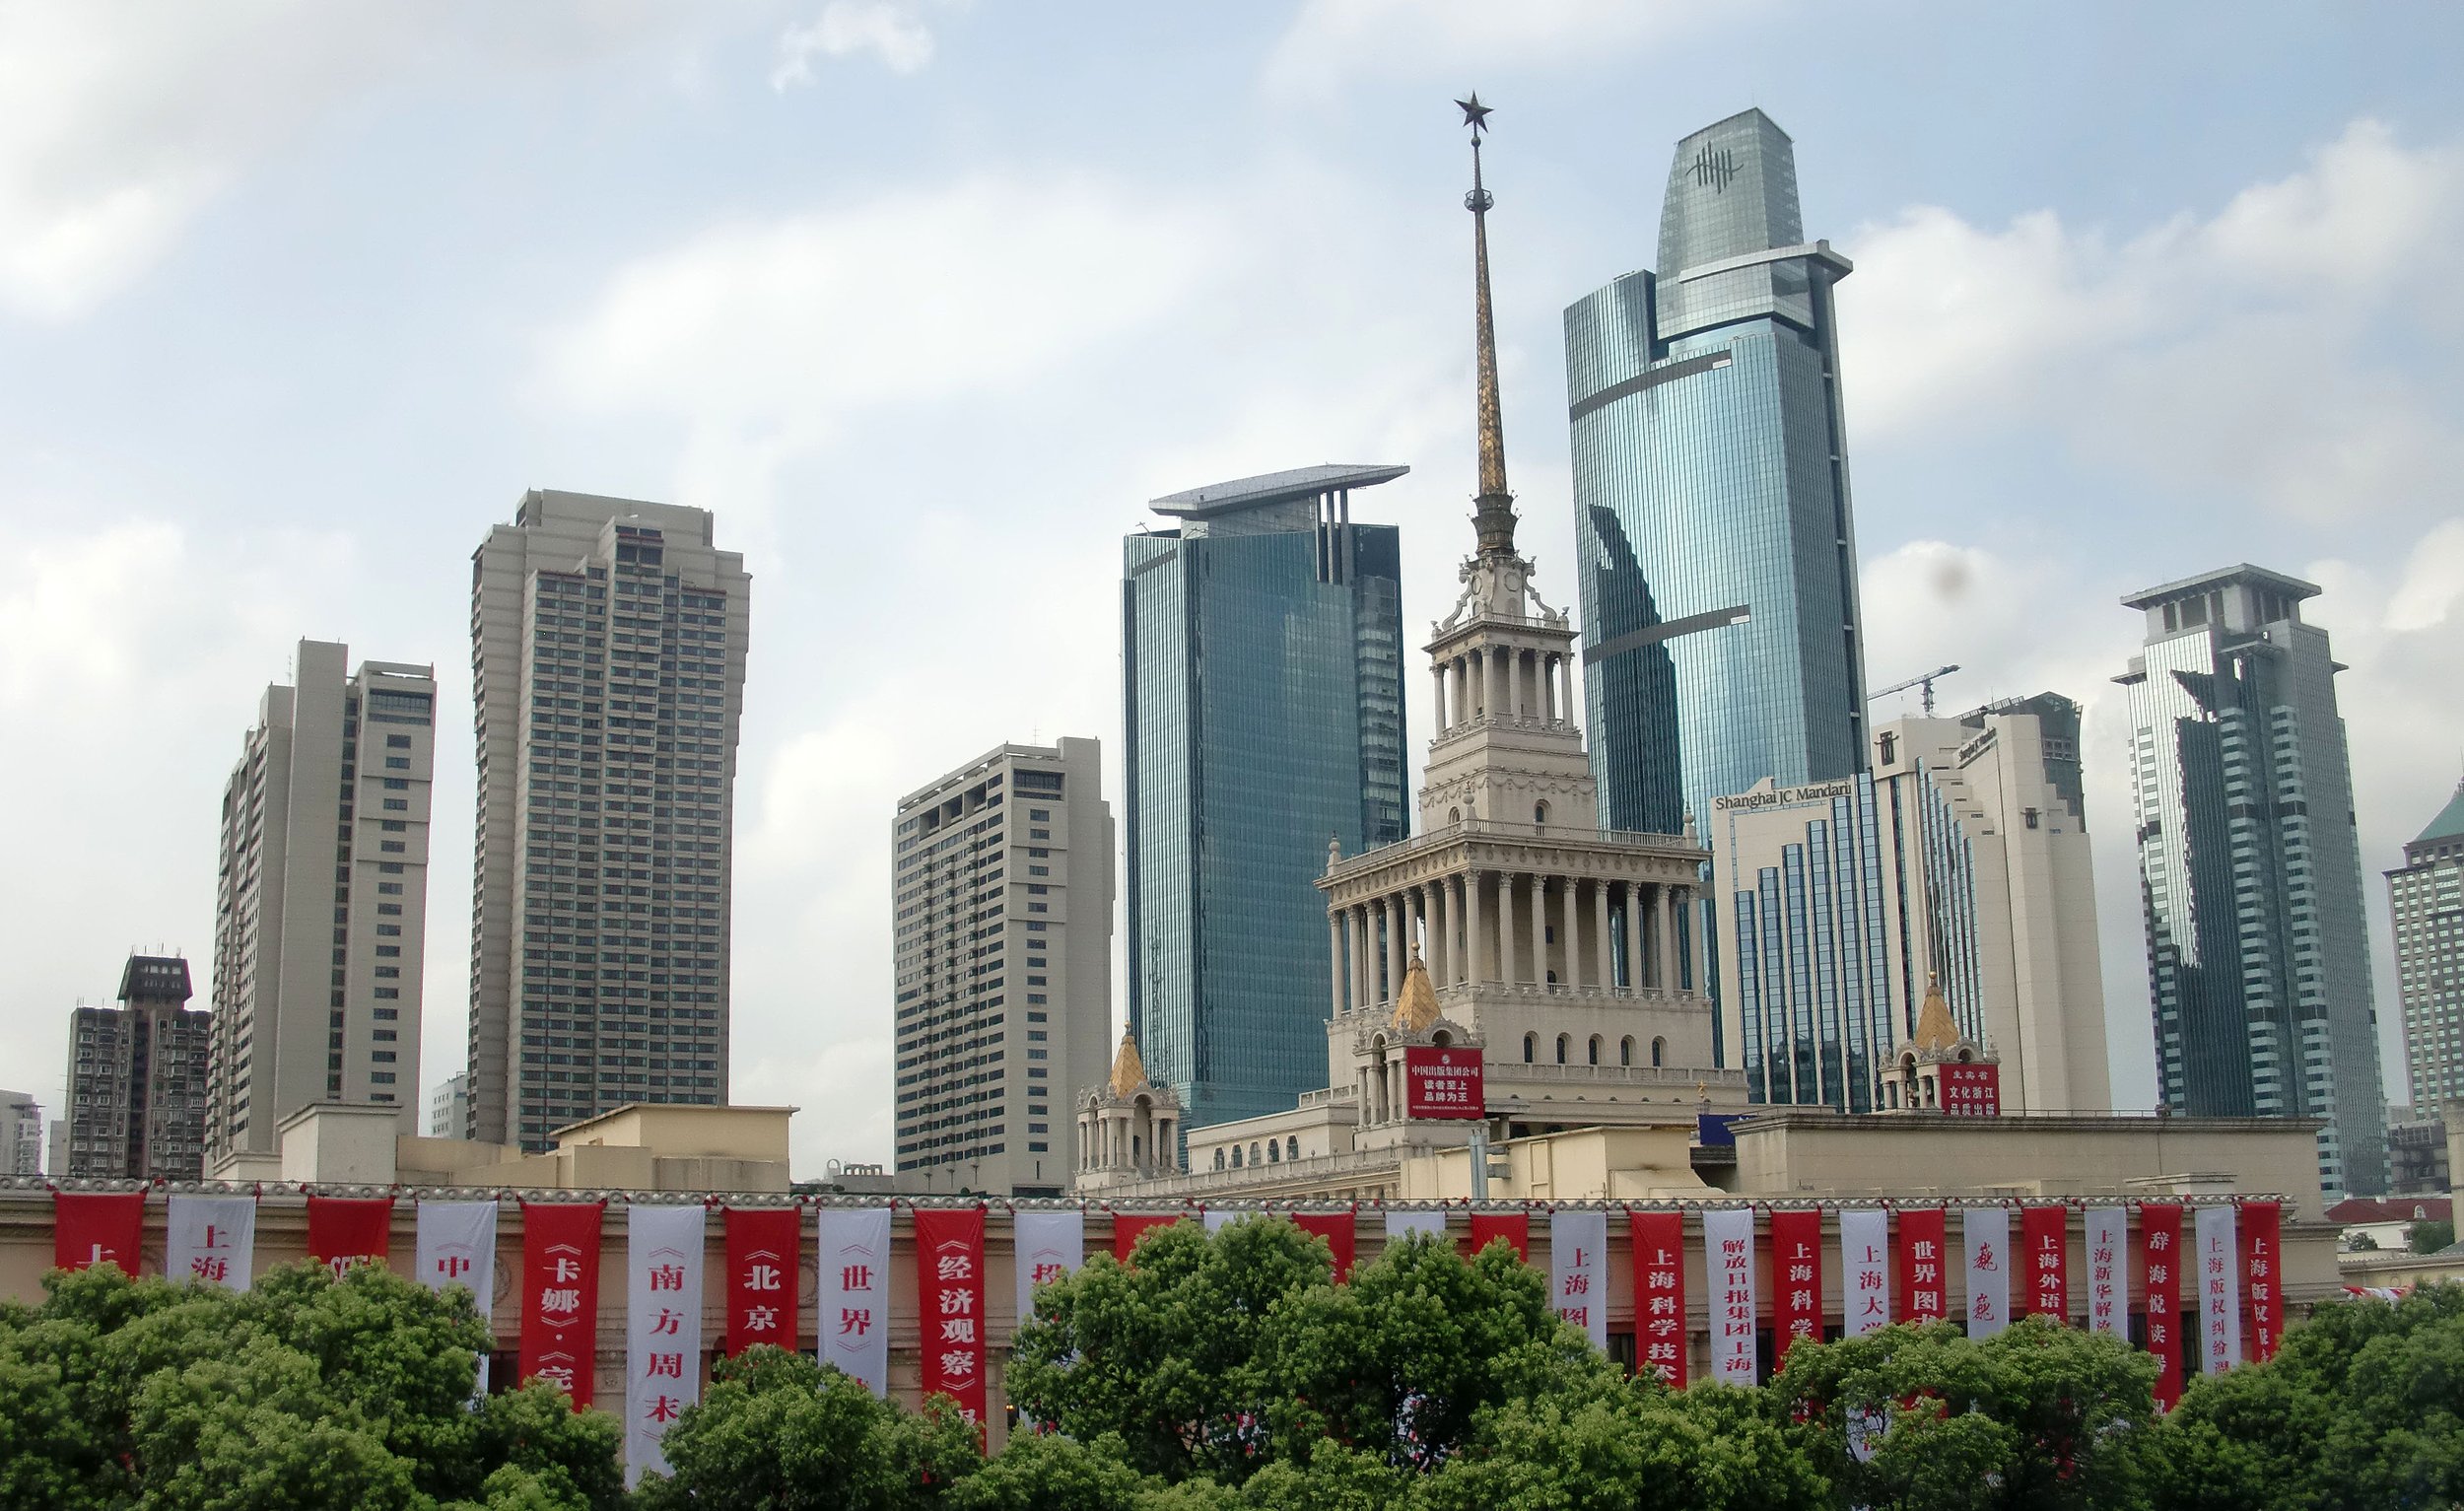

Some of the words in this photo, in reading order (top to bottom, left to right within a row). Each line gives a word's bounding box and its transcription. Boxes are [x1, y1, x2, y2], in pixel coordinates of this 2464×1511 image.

[1716, 790, 1777, 810] Shanghai
[1779, 790, 1793, 805] JC
[1411, 1065, 1478, 1076] 中国出版集团公司
[1424, 1079, 1468, 1090] 读者至上
[1950, 1086, 1994, 1099] 文化浙江
[1424, 1091, 1469, 1102] 品牌为王
[191, 1225, 231, 1281] 上海
[1561, 1248, 1591, 1328] 上海图
[1789, 1243, 1814, 1337] 上海科学
[1648, 1249, 1677, 1380] 上海科学技术
